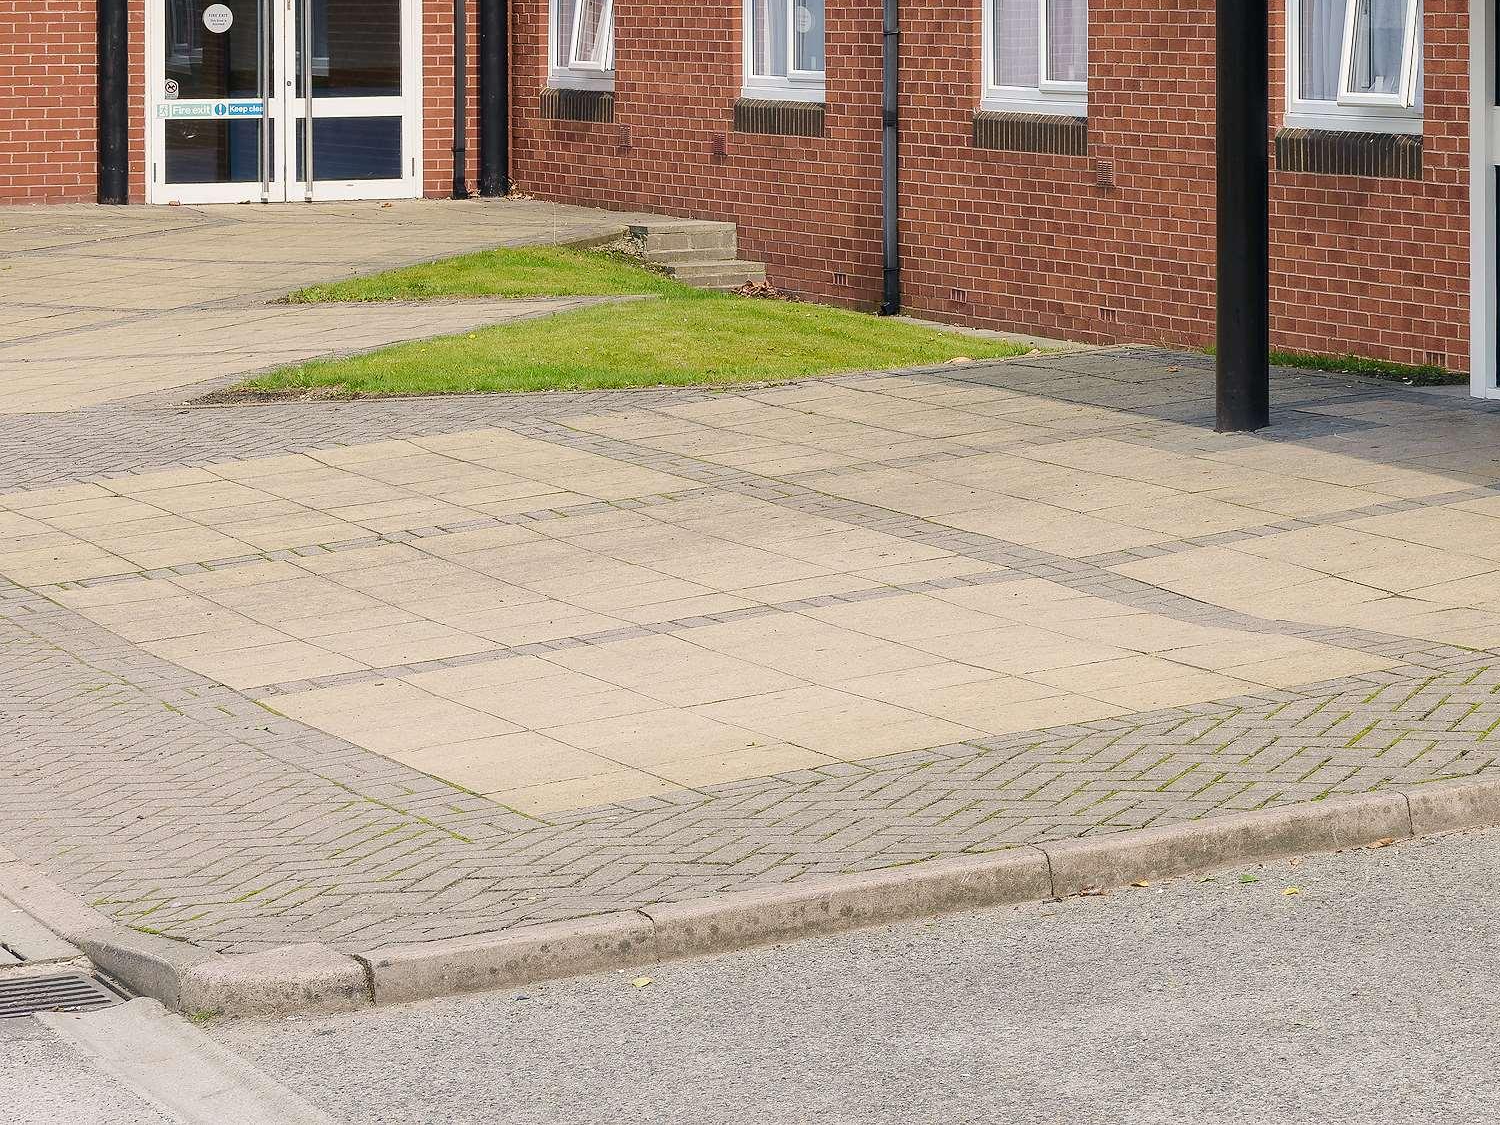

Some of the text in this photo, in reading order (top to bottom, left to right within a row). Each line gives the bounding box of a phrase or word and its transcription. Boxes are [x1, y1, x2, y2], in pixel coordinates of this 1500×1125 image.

[173, 104, 263, 115] Fire exit Keep clea
